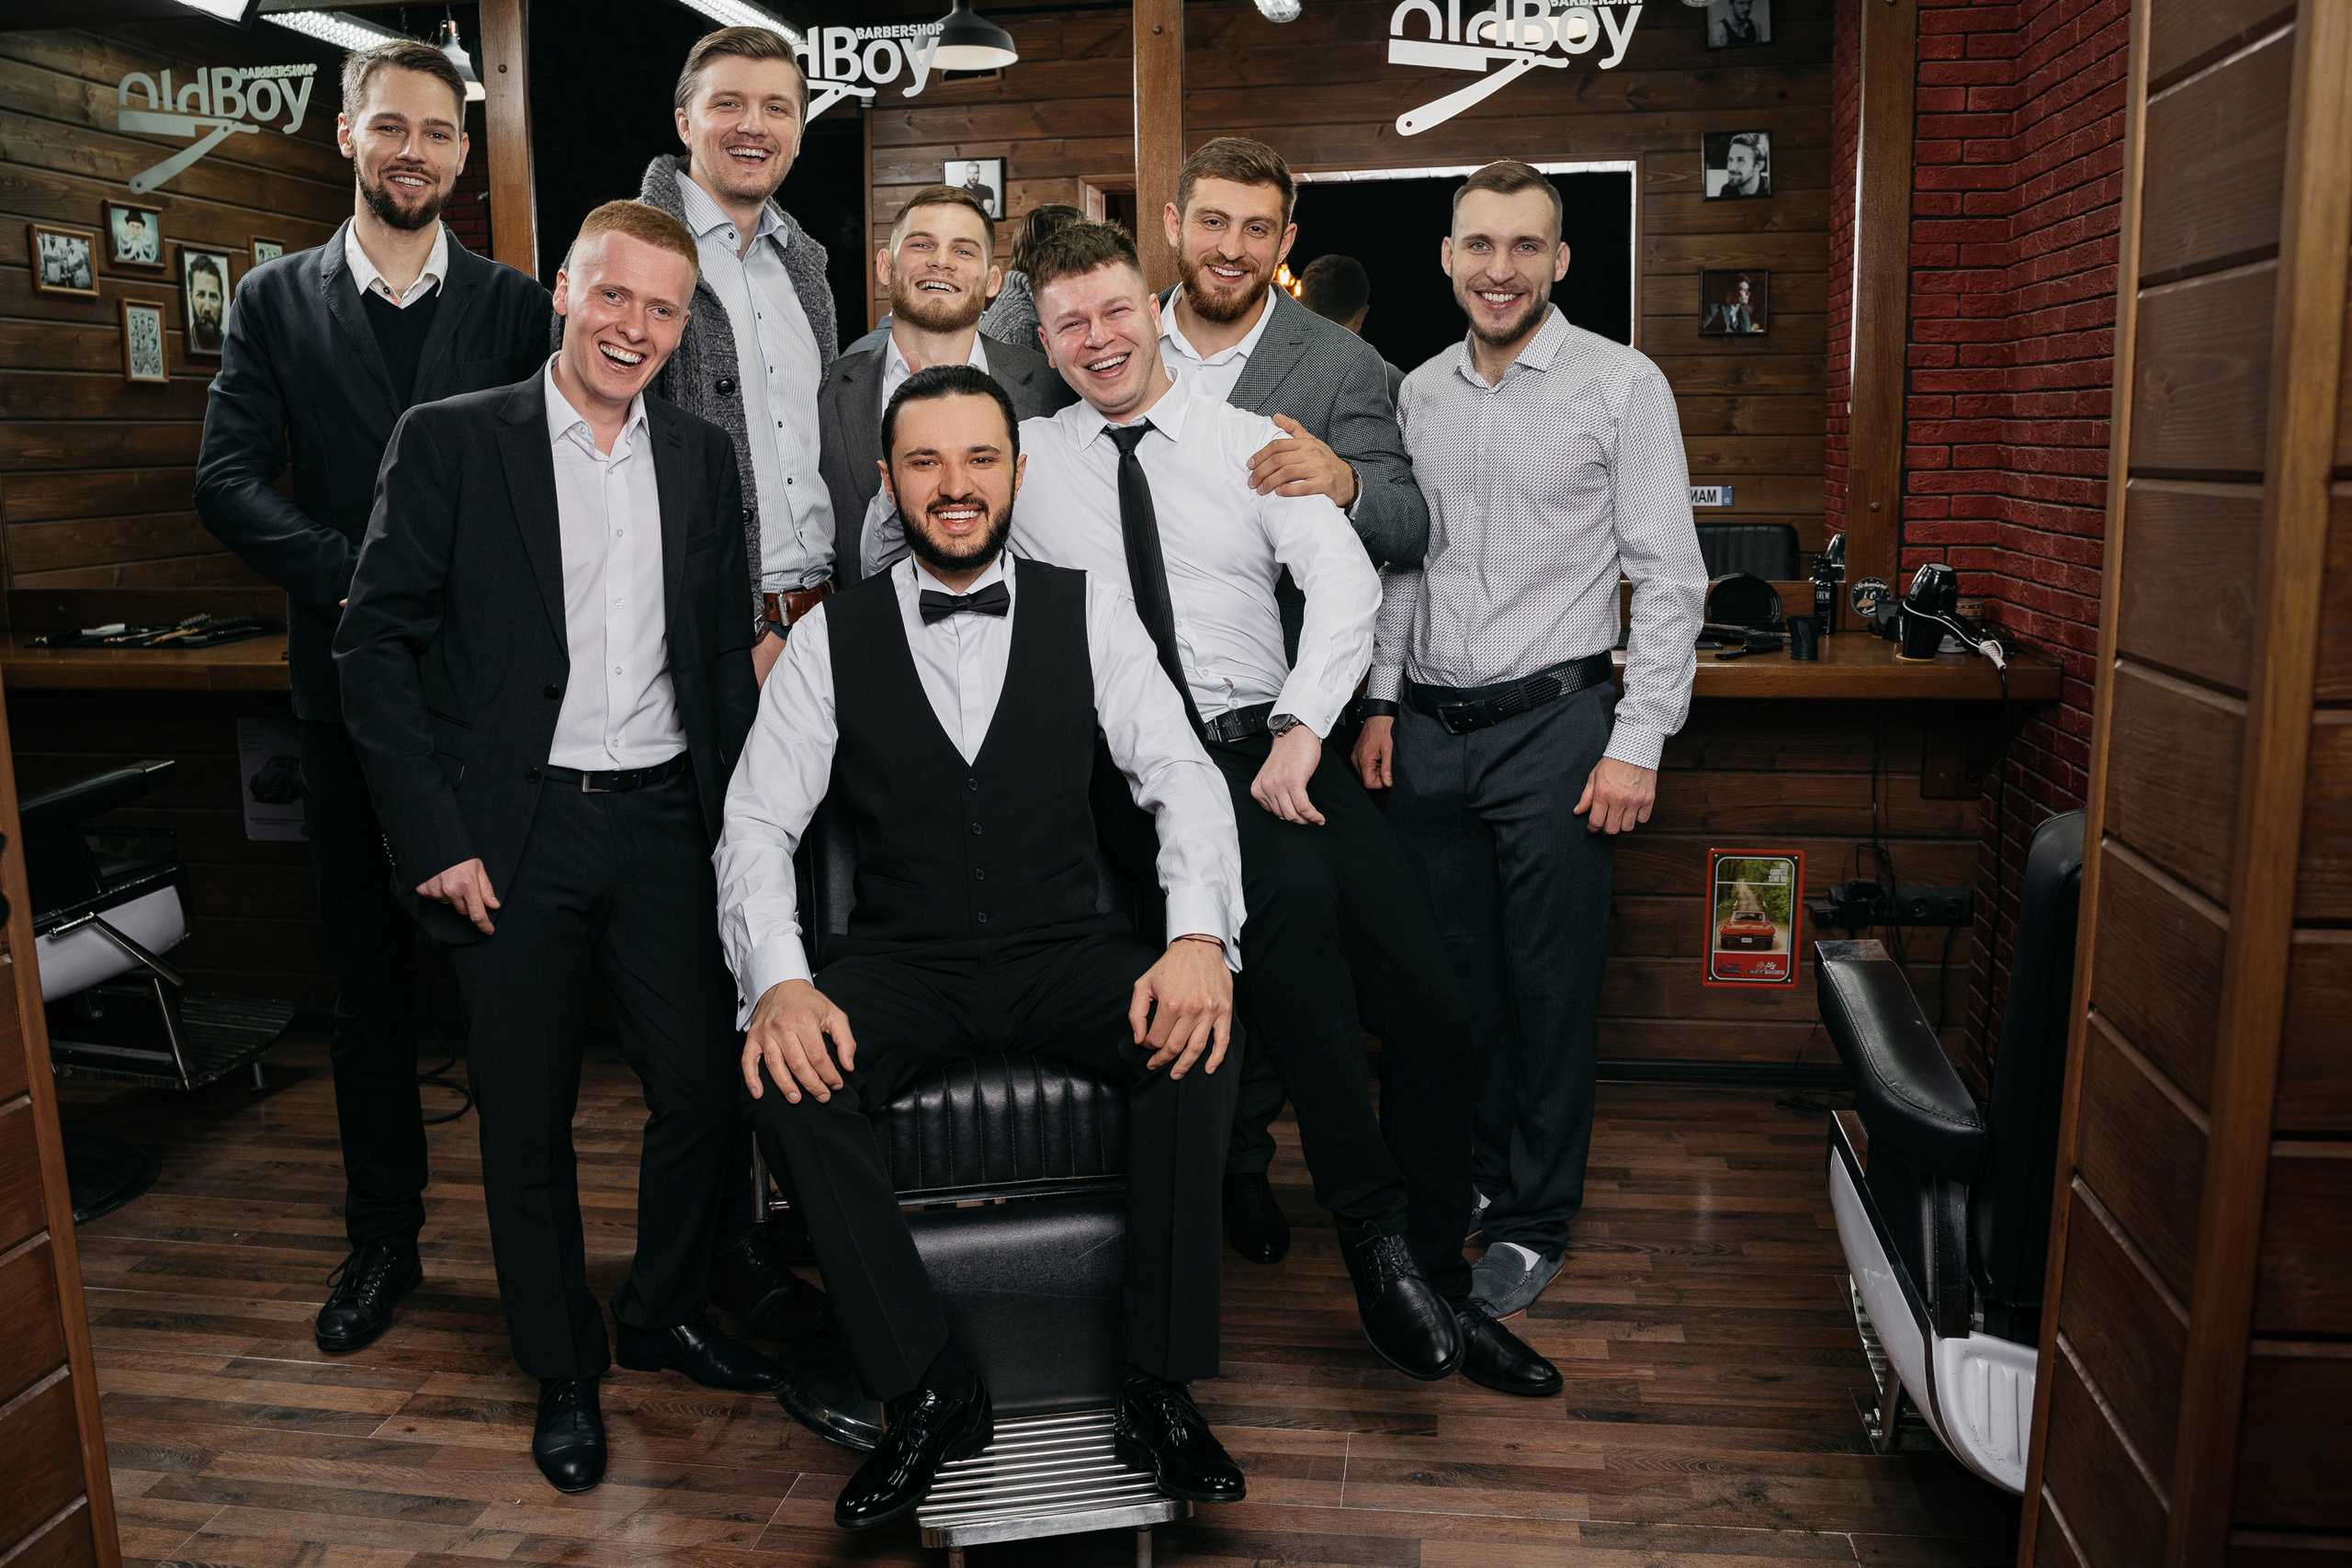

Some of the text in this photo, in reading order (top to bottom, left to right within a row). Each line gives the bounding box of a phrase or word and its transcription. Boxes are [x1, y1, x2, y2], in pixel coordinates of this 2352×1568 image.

[855, 23, 945, 39] BARBERSHOP
[792, 26, 941, 98] dBoy
[239, 63, 317, 80] BARBERSHOP
[118, 66, 314, 135] OldBoy
[1815, 591, 1831, 600] CREW
